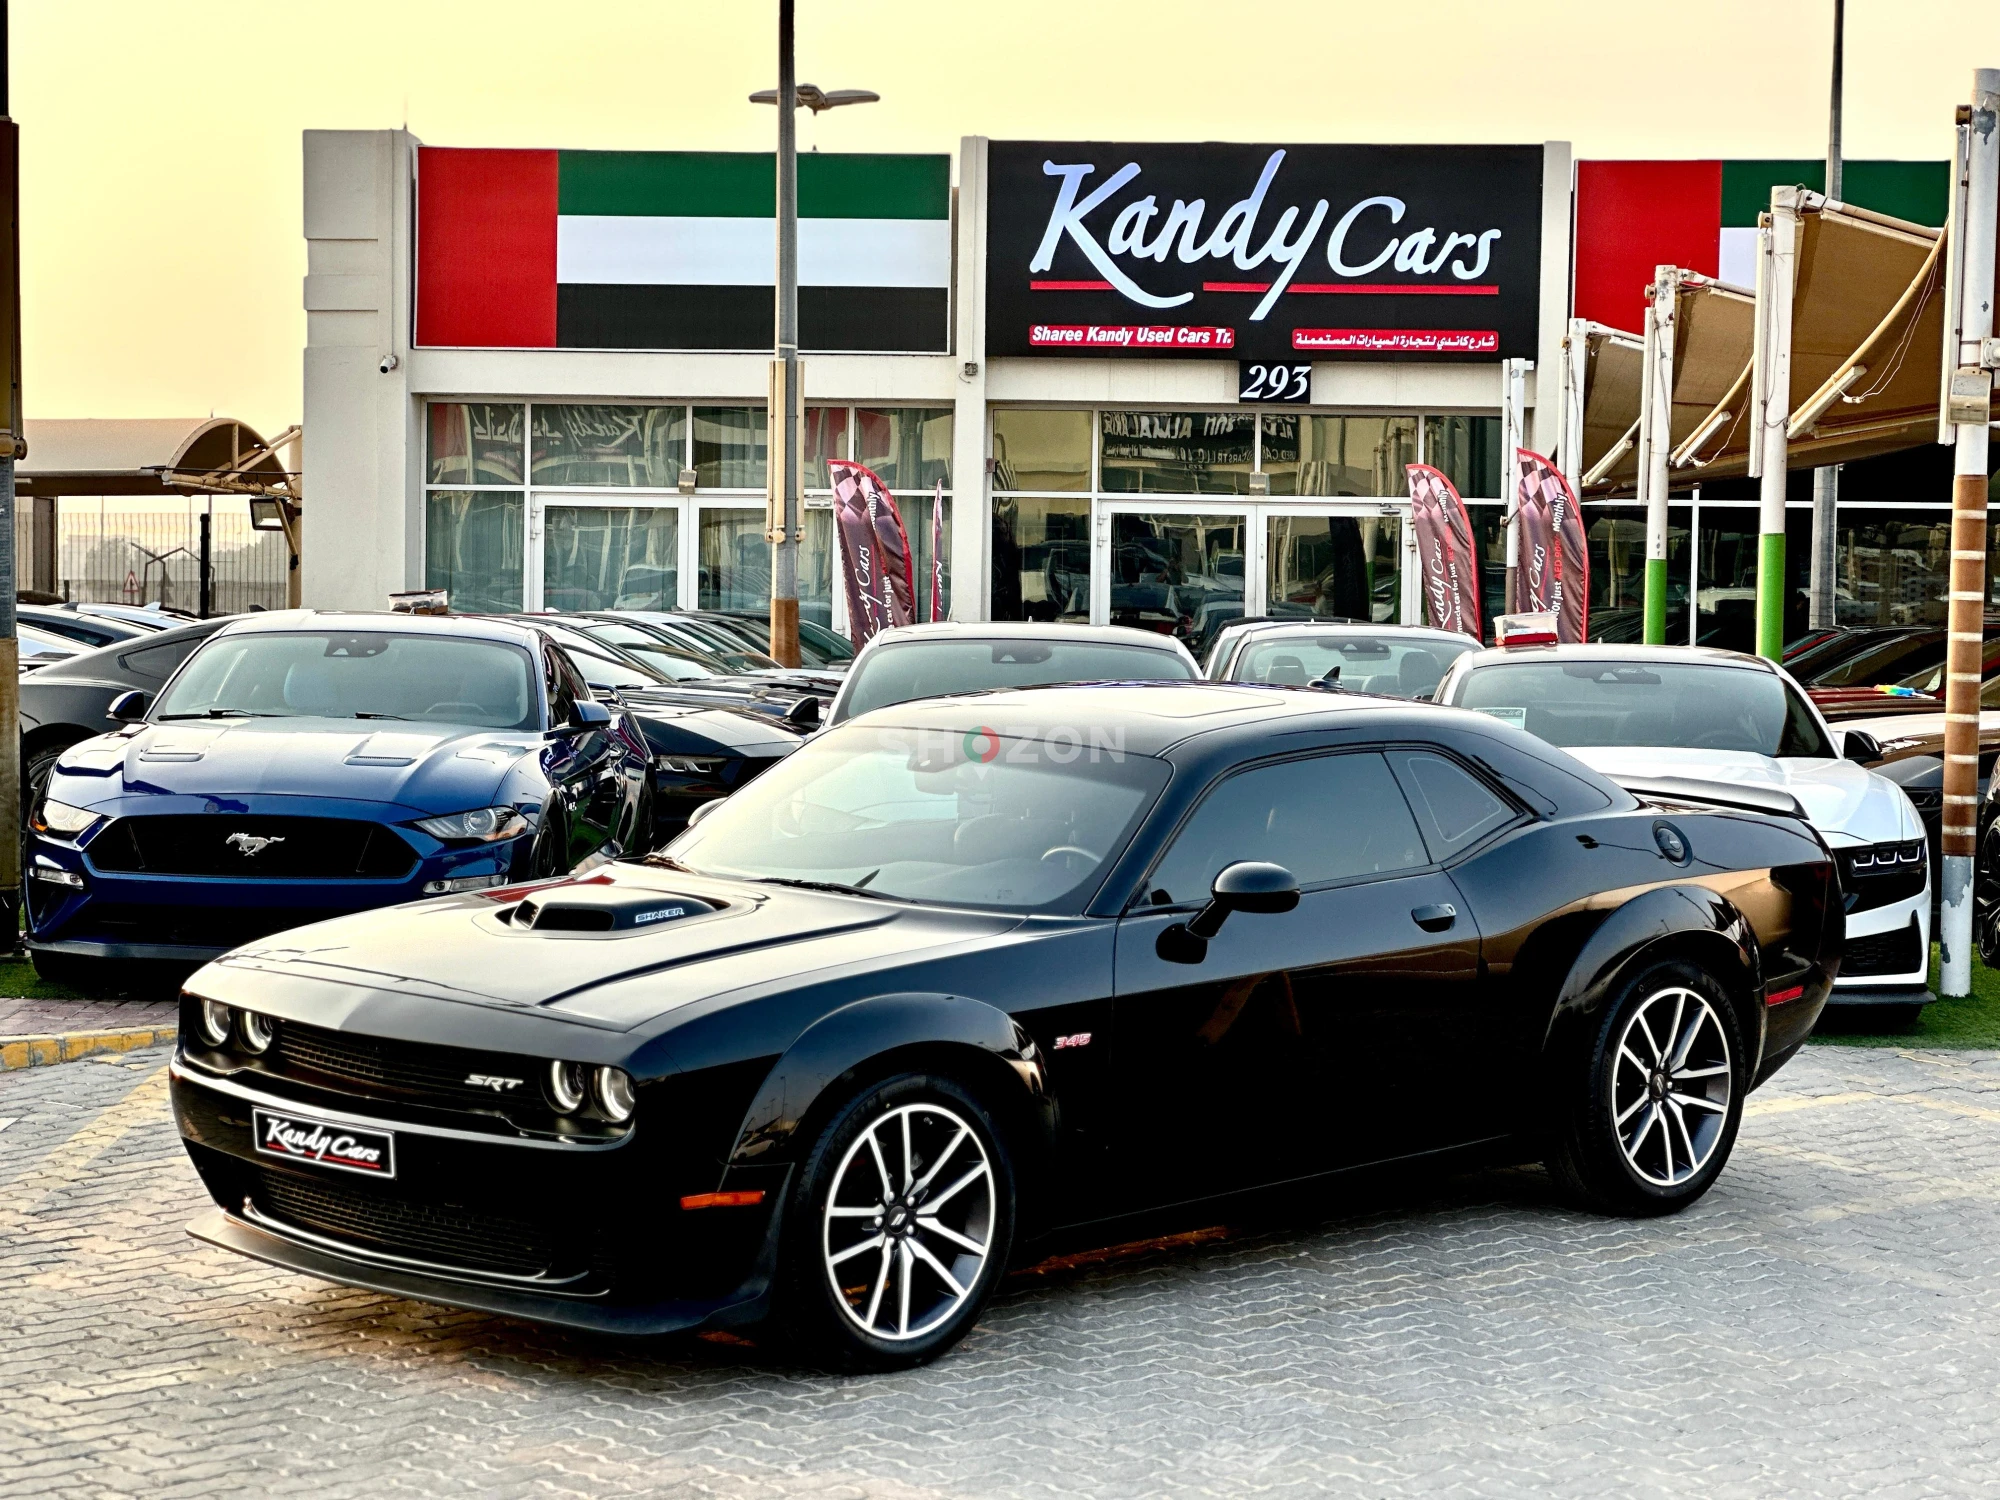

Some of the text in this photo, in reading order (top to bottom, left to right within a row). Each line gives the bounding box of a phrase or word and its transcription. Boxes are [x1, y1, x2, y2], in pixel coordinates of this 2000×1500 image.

[1029, 149, 1502, 320] Kandy Cars
[1032, 326, 1232, 346] Sharee Kandy Used Cars Tr.
[1296, 333, 1495, 350] شارع كاندي لتجارة السيارات المستعملة
[1240, 365, 1311, 399] 293
[1431, 537, 1444, 574] Cars
[855, 545, 870, 587] Cars
[1449, 563, 1458, 578] just
[1530, 544, 1545, 588] Cars
[1553, 560, 1563, 580] AED
[883, 576, 894, 593] just
[1551, 581, 1564, 600] just
[1454, 605, 1463, 632] muscle
[635, 908, 685, 923] SHAKER
[1053, 1033, 1092, 1050] 345
[464, 1074, 524, 1092] SRT
[266, 1118, 381, 1161] Kandy Cars
